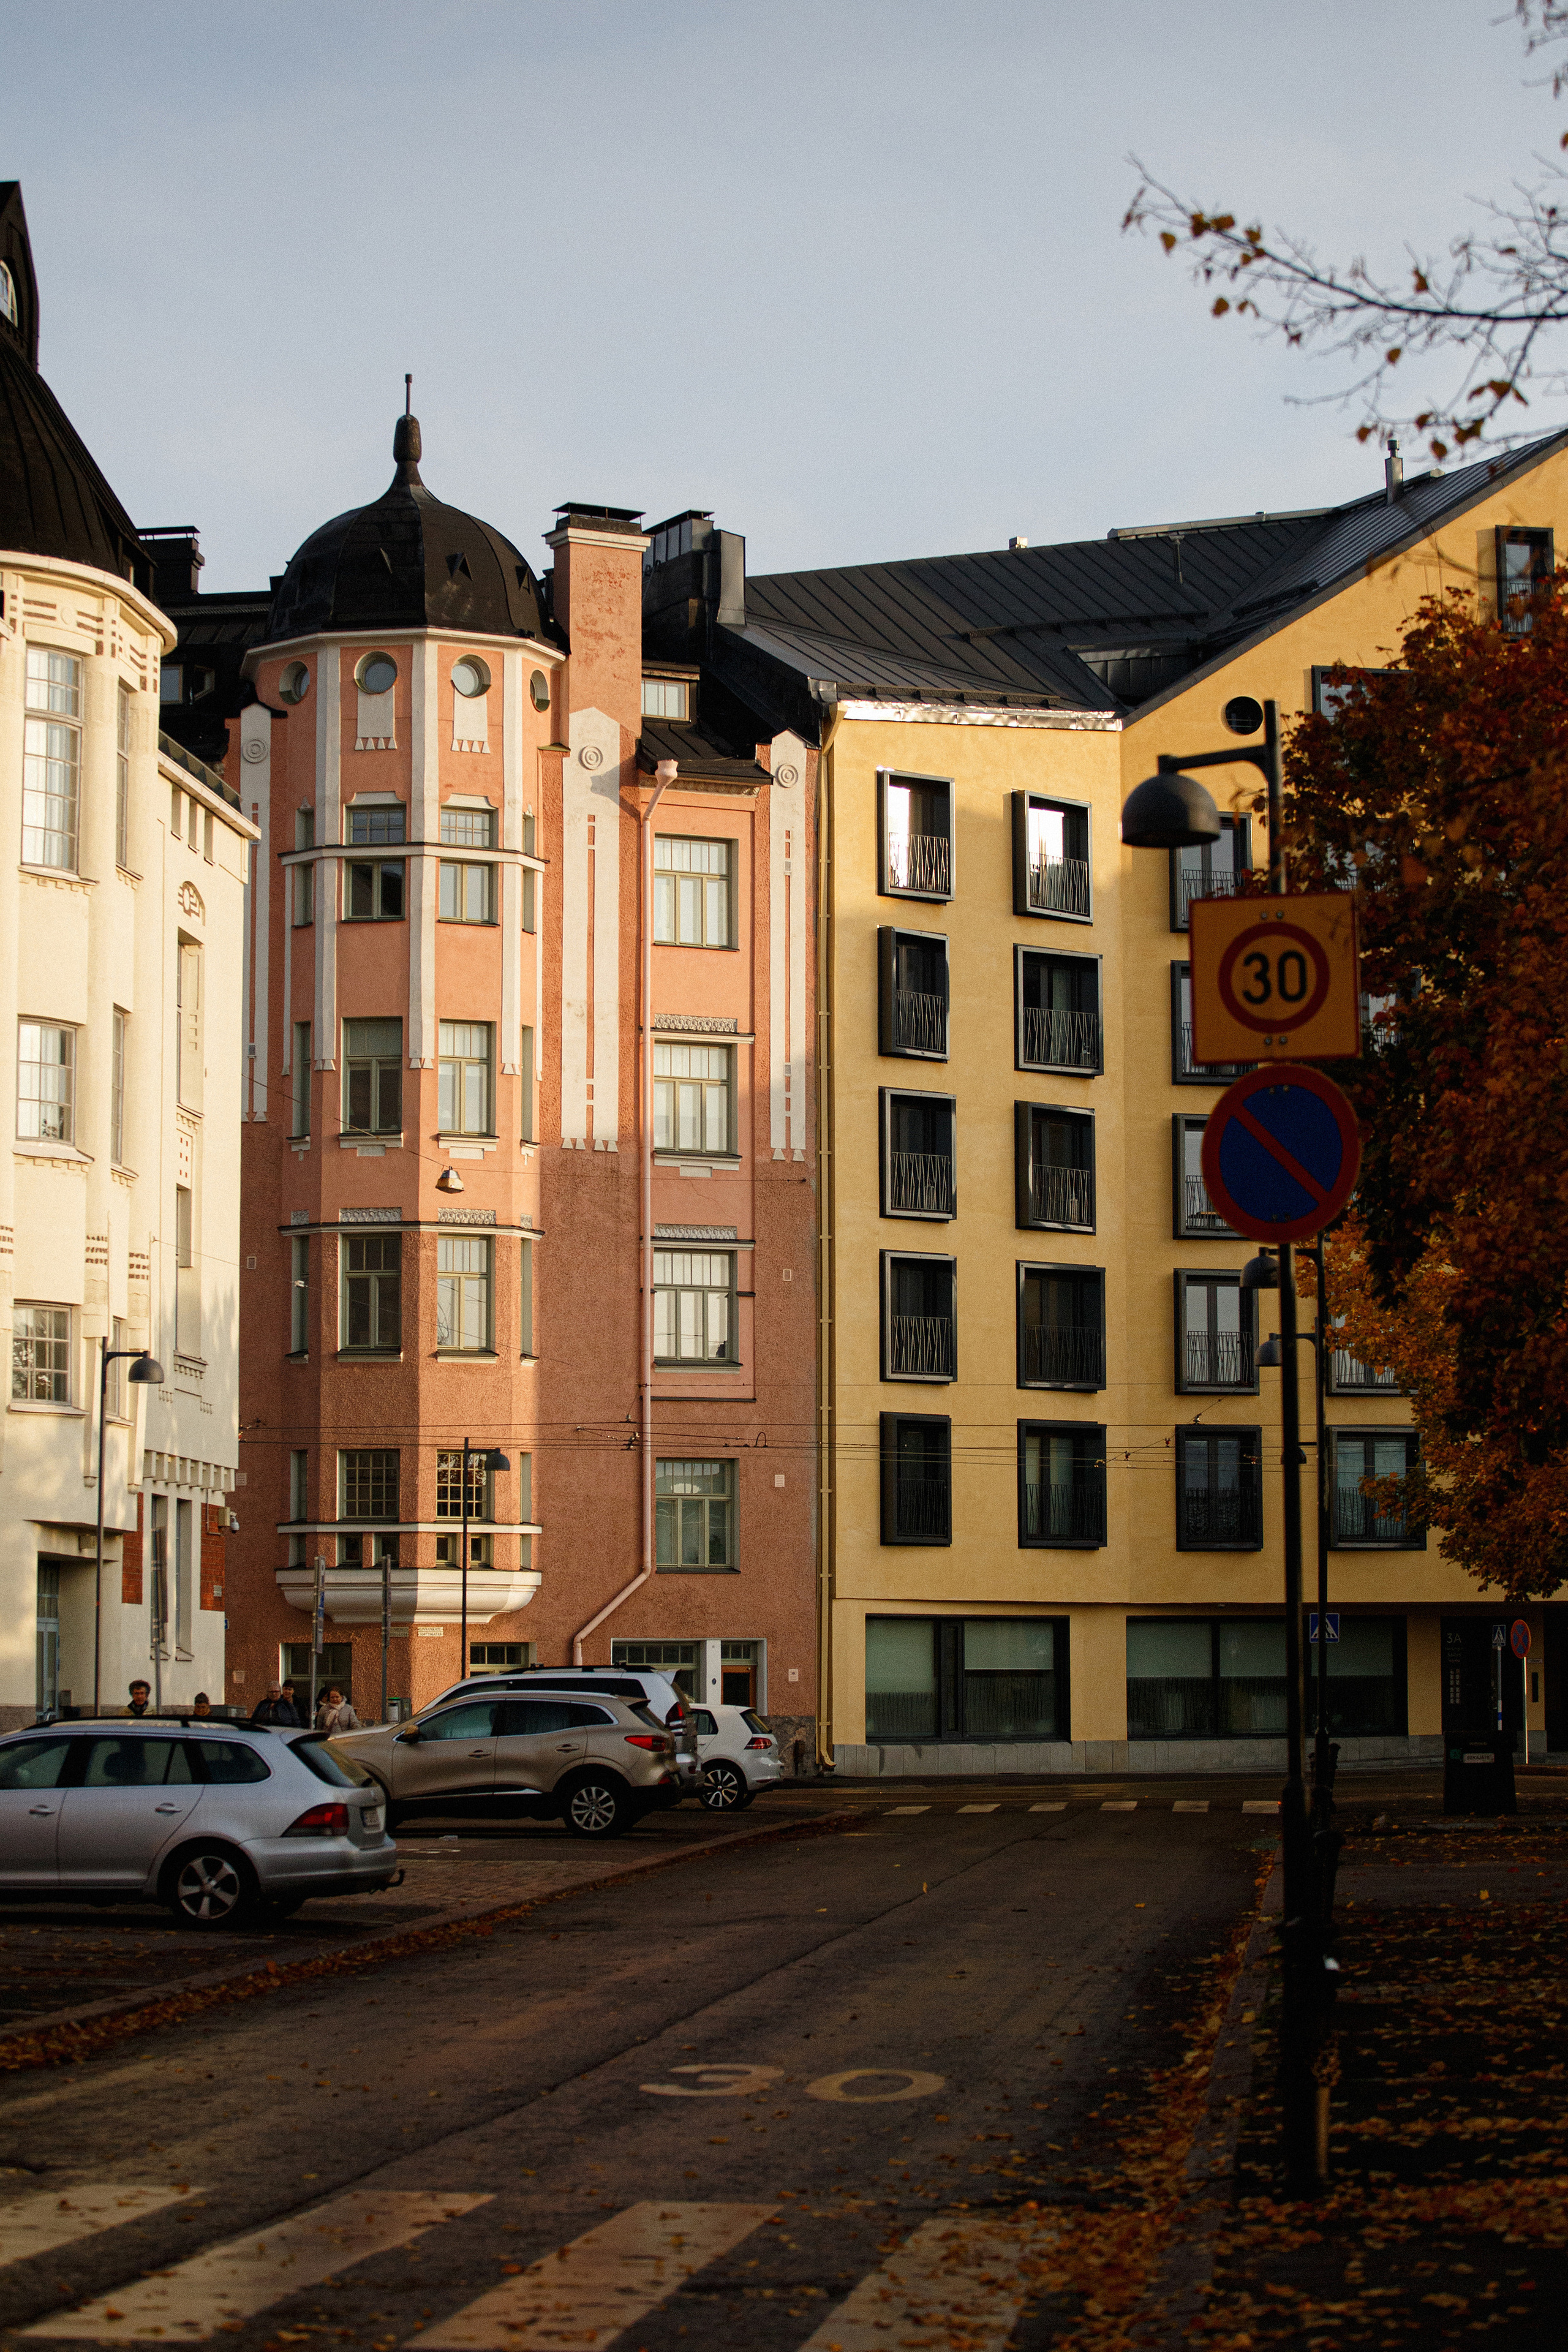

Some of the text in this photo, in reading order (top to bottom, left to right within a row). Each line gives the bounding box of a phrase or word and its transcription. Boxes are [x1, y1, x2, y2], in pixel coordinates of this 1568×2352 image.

[1243, 951, 1306, 1005] 30
[1447, 1633, 1461, 1644] 3A
[639, 2064, 946, 2102] 30
